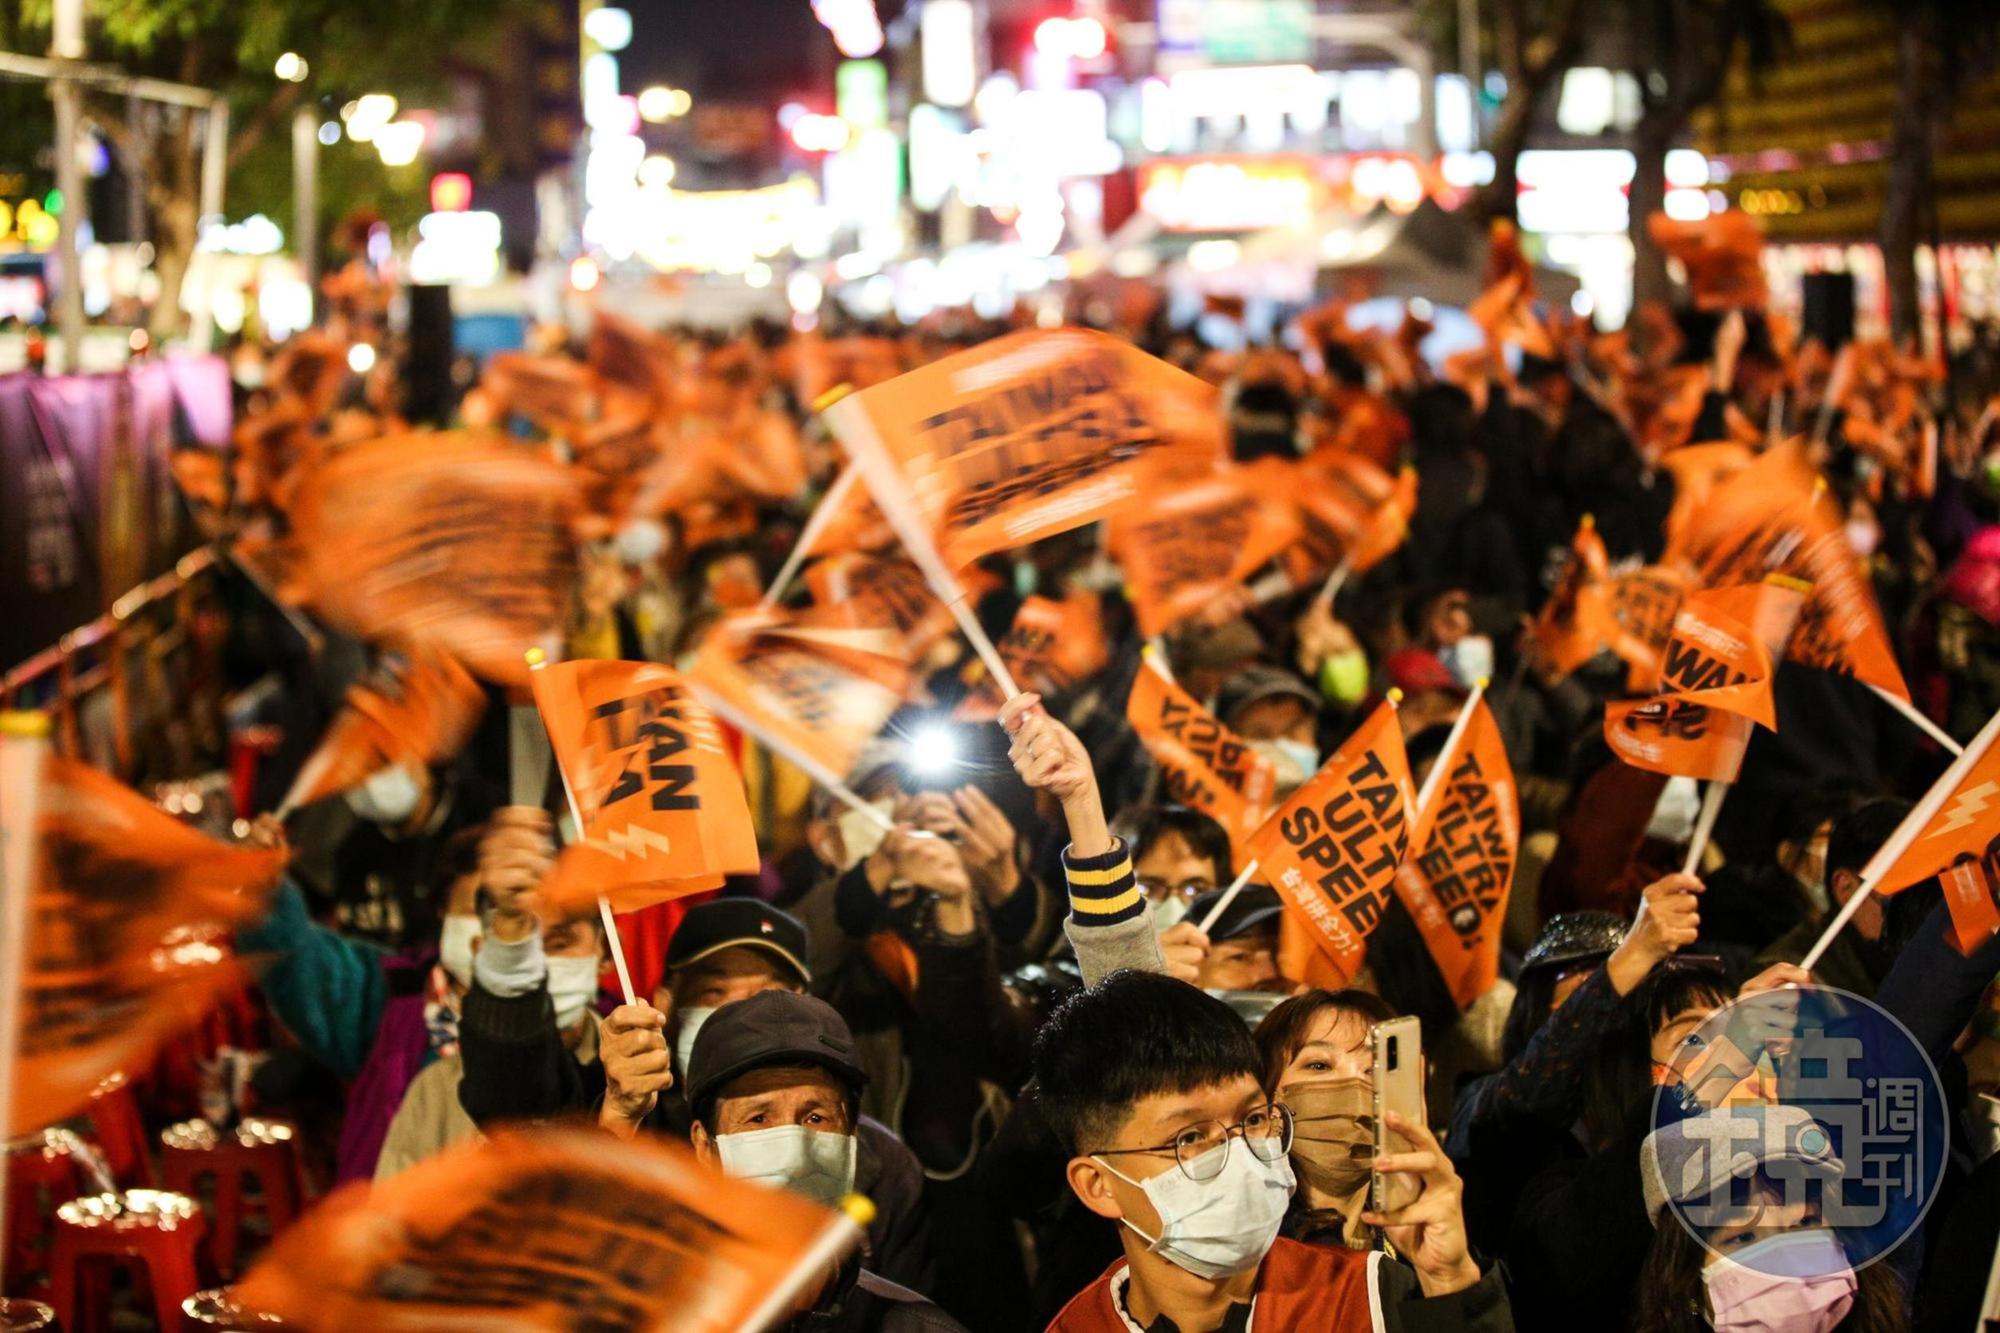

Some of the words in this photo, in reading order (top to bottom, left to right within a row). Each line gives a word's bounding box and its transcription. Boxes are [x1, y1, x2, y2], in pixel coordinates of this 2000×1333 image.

[1323, 790, 1397, 898] ULT
[1347, 749, 1409, 852] TAI
[1418, 826, 1483, 949] EED!
